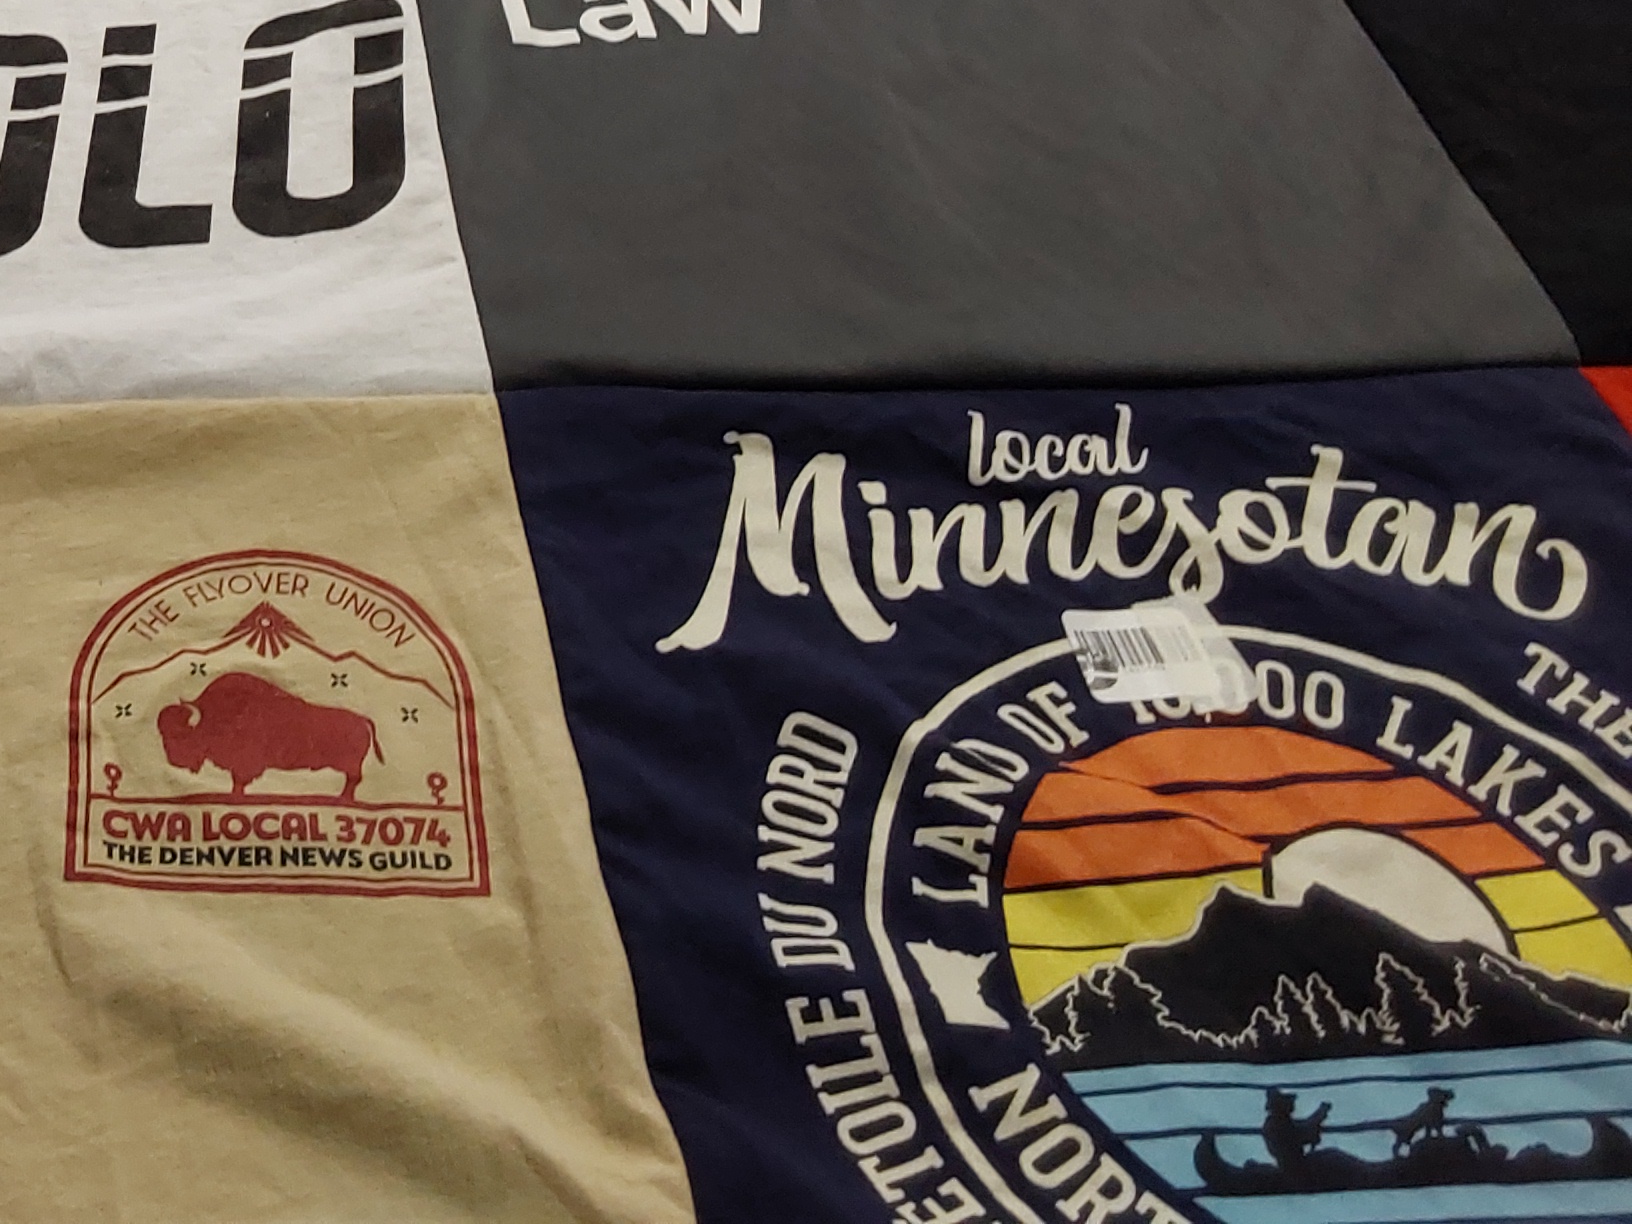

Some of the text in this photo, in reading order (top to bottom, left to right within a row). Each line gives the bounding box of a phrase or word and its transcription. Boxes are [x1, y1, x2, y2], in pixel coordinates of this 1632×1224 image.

[967, 403, 1149, 487] local
[655, 428, 1588, 654] Minnesotan
[127, 571, 416, 649] THE FLYOVER UNION
[101, 809, 452, 848] CWA LOCAL 37074
[756, 708, 860, 885] NORD
[911, 737, 1030, 910] LAND
[996, 680, 1090, 755] OF
[1375, 694, 1632, 878] LAKES
[102, 840, 453, 872] THE DENVER NEWS GUILD
[756, 891, 856, 972] DU
